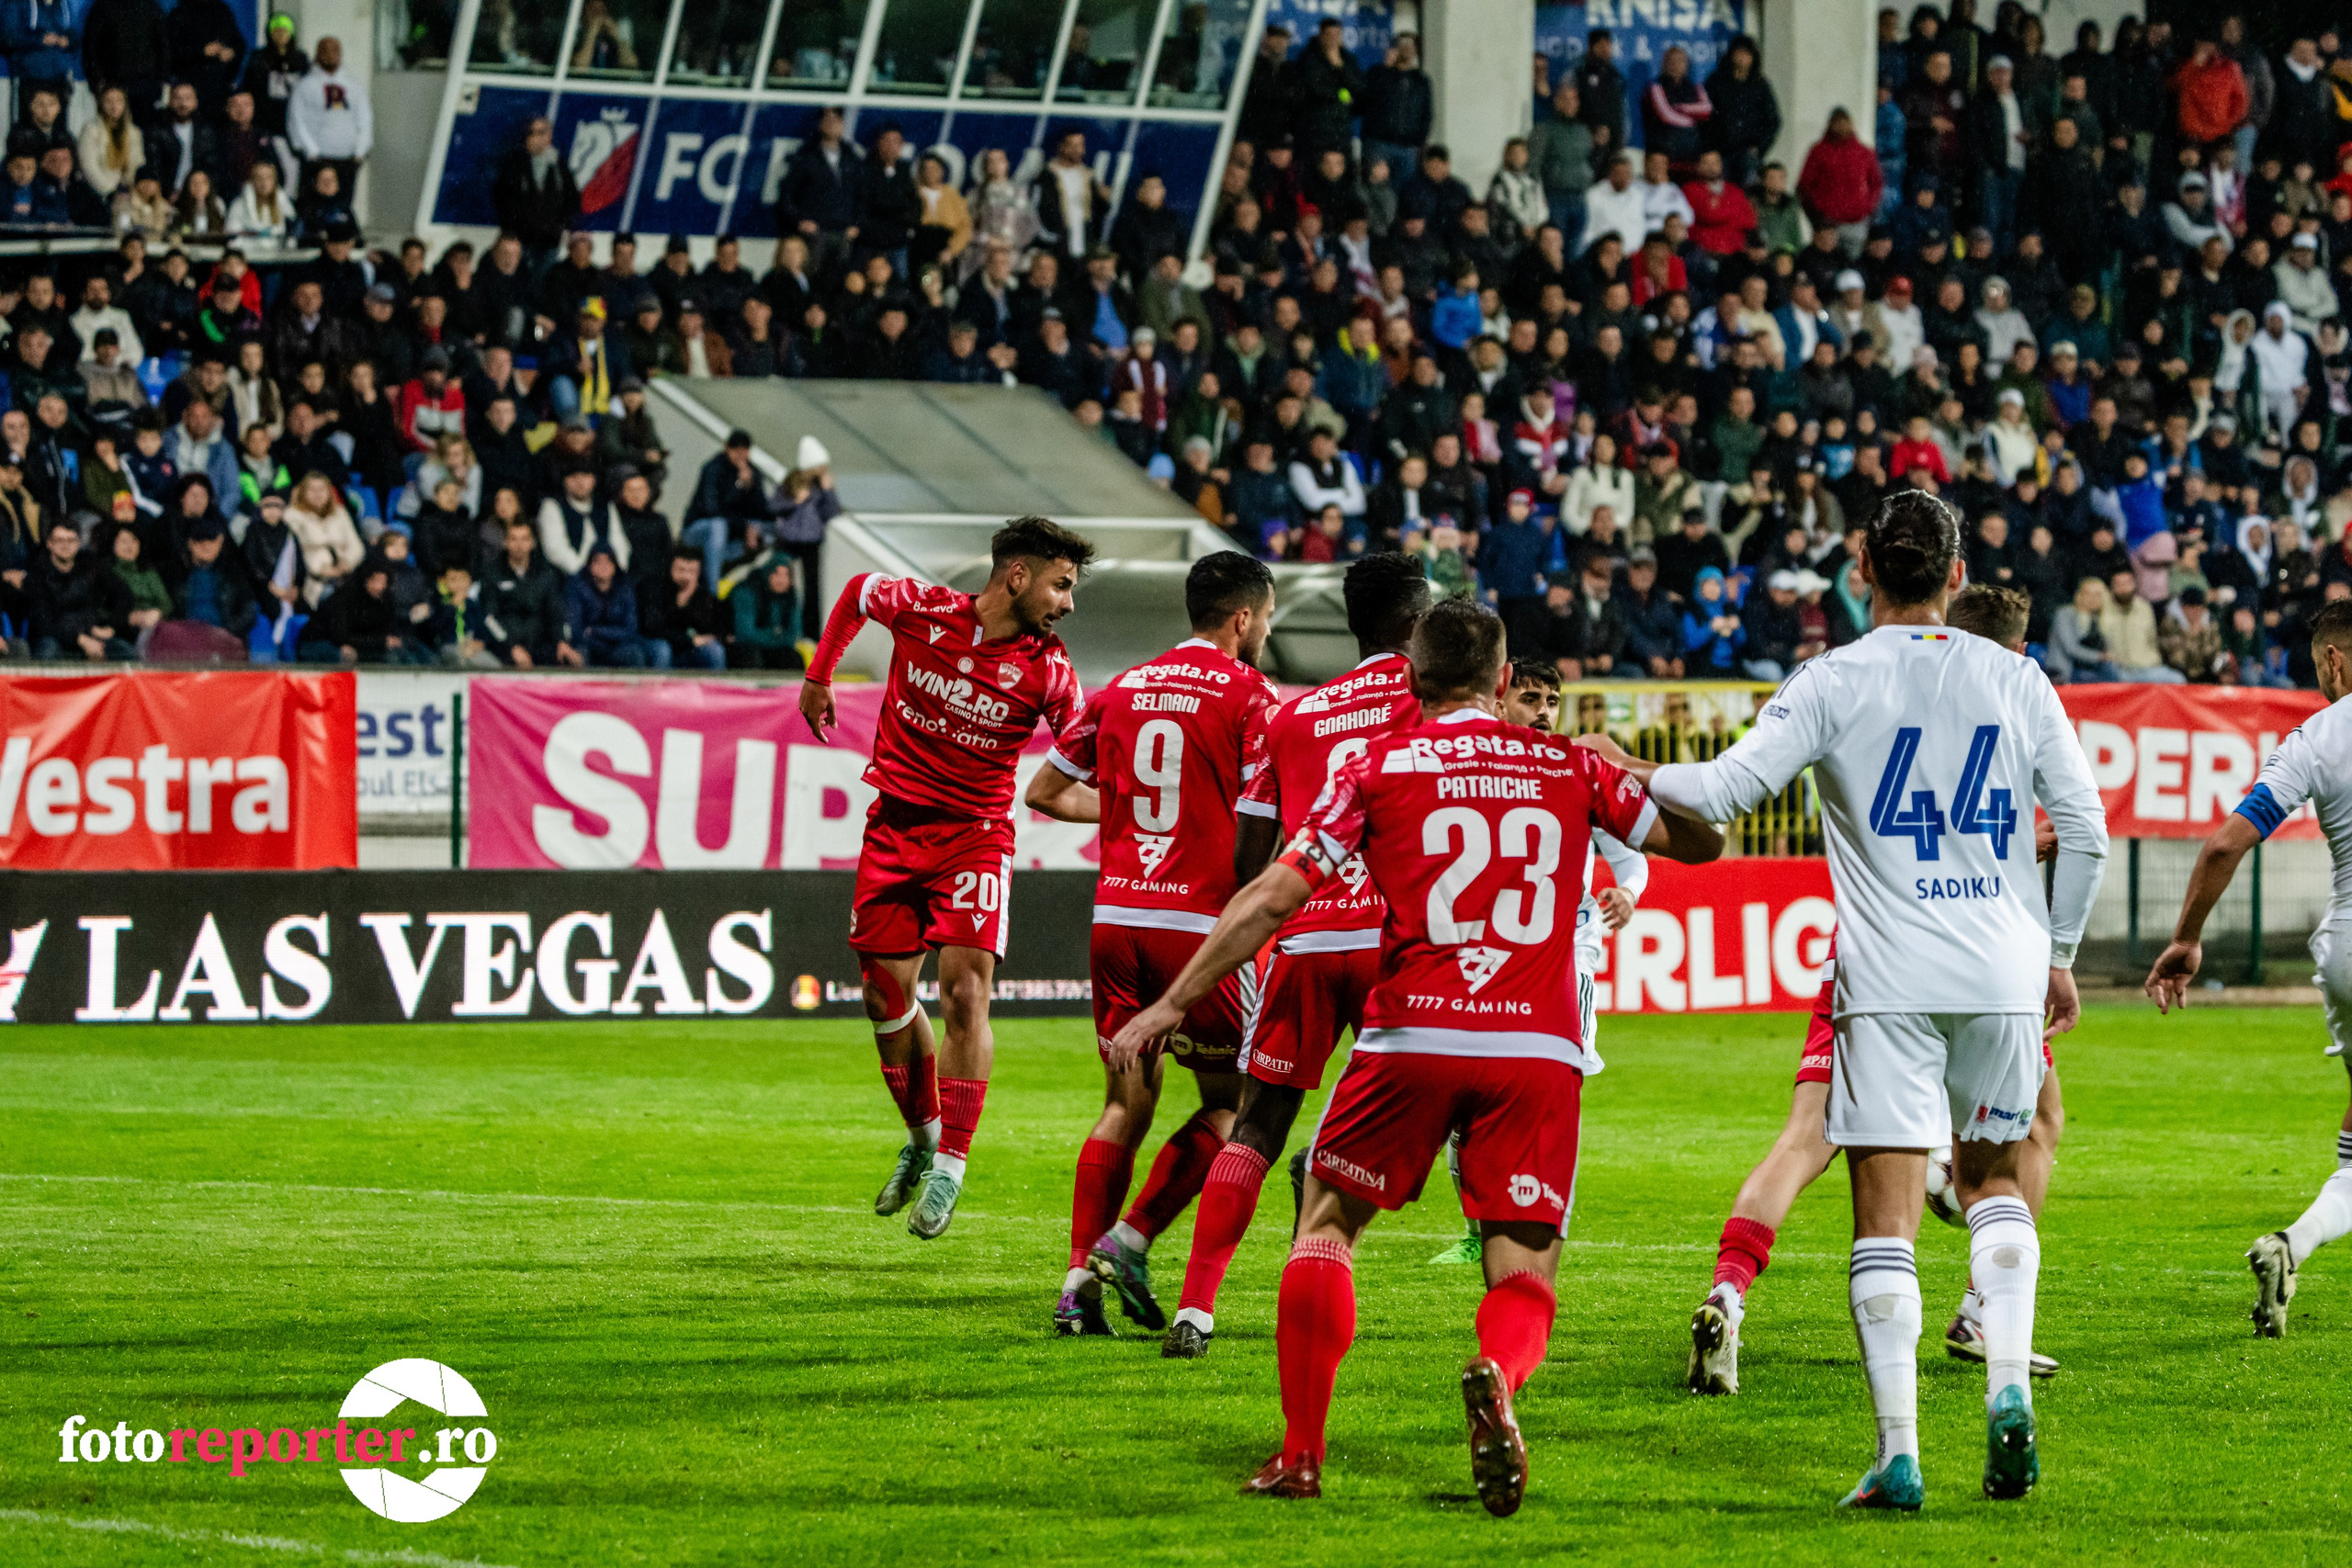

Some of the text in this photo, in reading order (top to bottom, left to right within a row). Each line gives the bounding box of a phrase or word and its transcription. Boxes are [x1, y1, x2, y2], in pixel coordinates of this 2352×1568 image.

[655, 131, 749, 204] FC
[1139, 663, 1231, 684] Regata.ro
[908, 660, 1009, 721] WIN2.RO
[1131, 693, 1201, 714] SELMANI
[945, 703, 972, 719] CASINO
[978, 717, 1002, 728] SPORT
[1314, 703, 1393, 738] GNAHORÉ
[1410, 734, 1566, 761] Regata.ro
[1133, 718, 1184, 832] 9
[1444, 760, 1479, 771] Gresie
[1437, 775, 1543, 800] PATRICHE
[1870, 725, 2017, 861] 44
[953, 871, 999, 911] 20
[1130, 879, 1189, 895] GAMING
[1422, 806, 1562, 945] 23
[1916, 876, 1999, 899] SADIKU
[75, 908, 775, 1021] LAS VEGAS
[1408, 995, 1532, 1015] 7777 GAMING
[1317, 1149, 1385, 1191] CARPATINA
